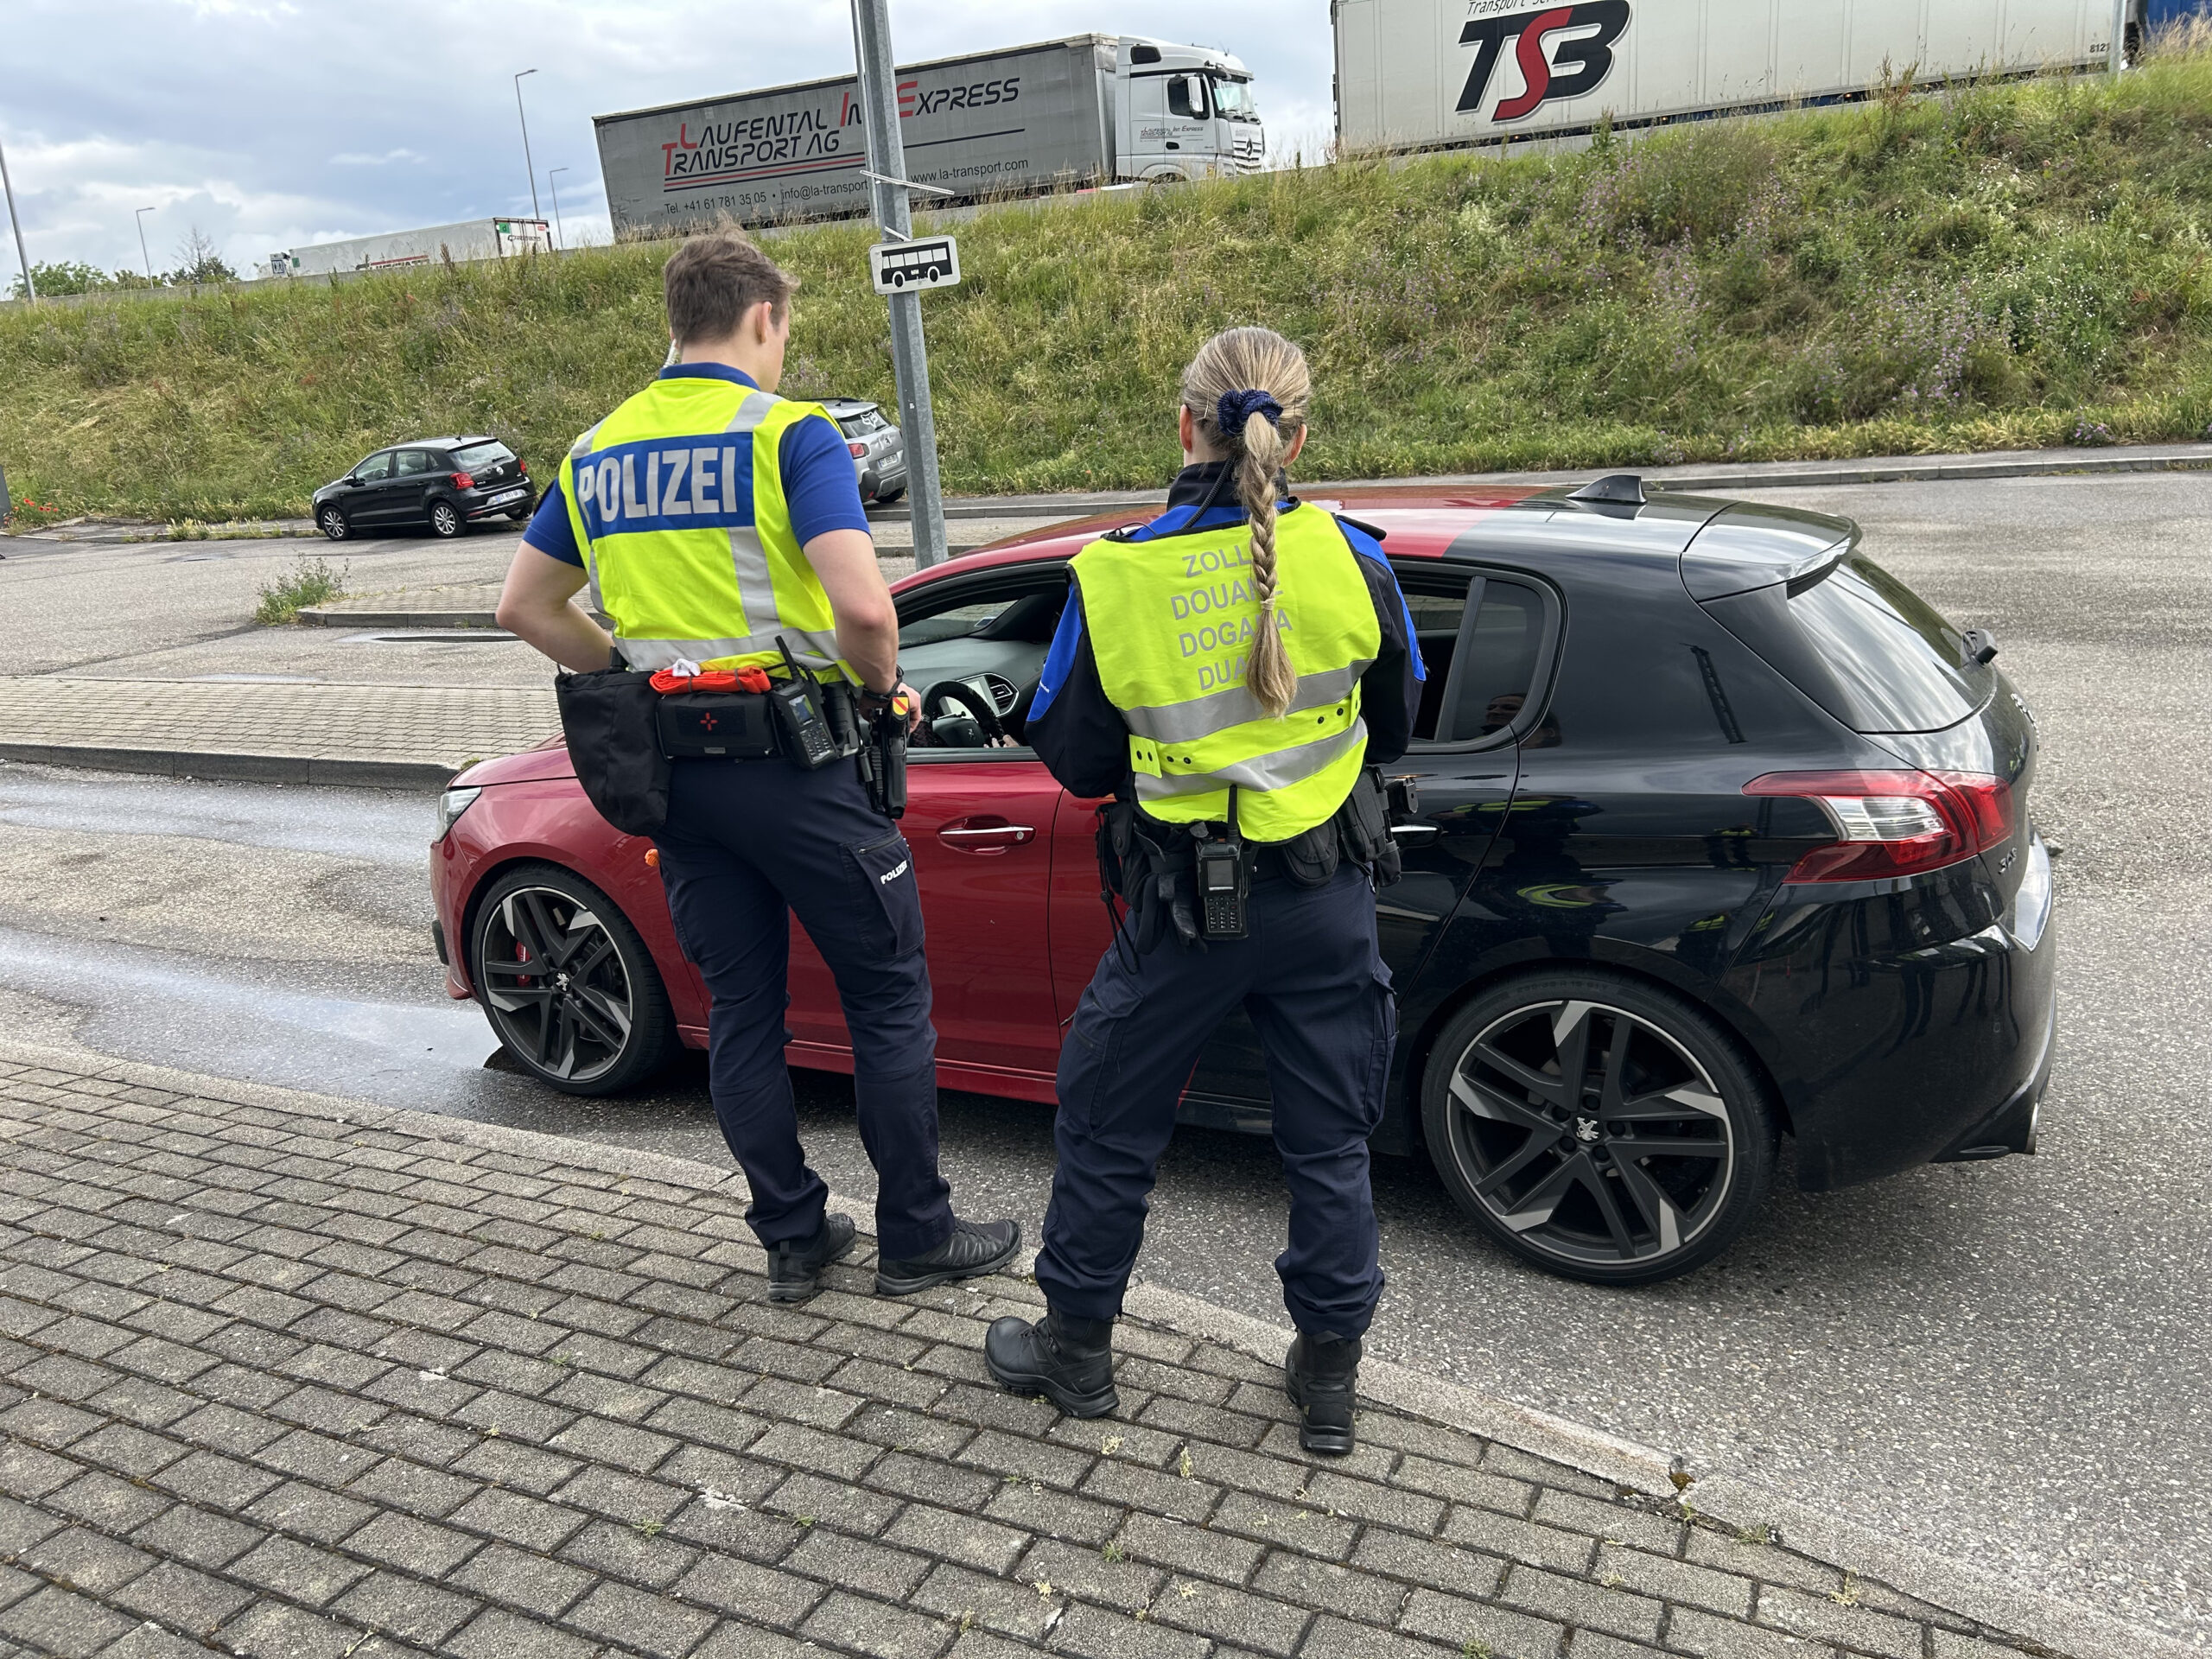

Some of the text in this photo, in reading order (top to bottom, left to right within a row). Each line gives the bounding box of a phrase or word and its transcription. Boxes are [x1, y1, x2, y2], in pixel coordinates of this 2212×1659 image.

[1455, 0, 1630, 122] TSB
[680, 77, 1020, 149] LAUFENTAL IN EXPRESS
[661, 130, 840, 175] TRANSPORT AG
[910, 158, 1029, 183] www.la-transport.com
[664, 179, 868, 214] Tel. +41 61 781 35 05 info@la-transport
[577, 446, 738, 529] POLIZEI
[1182, 544, 1253, 578] ZOLL
[1171, 577, 1283, 620] DOUA
[1179, 608, 1294, 658] DOGAA
[1198, 656, 1248, 690] DUA
